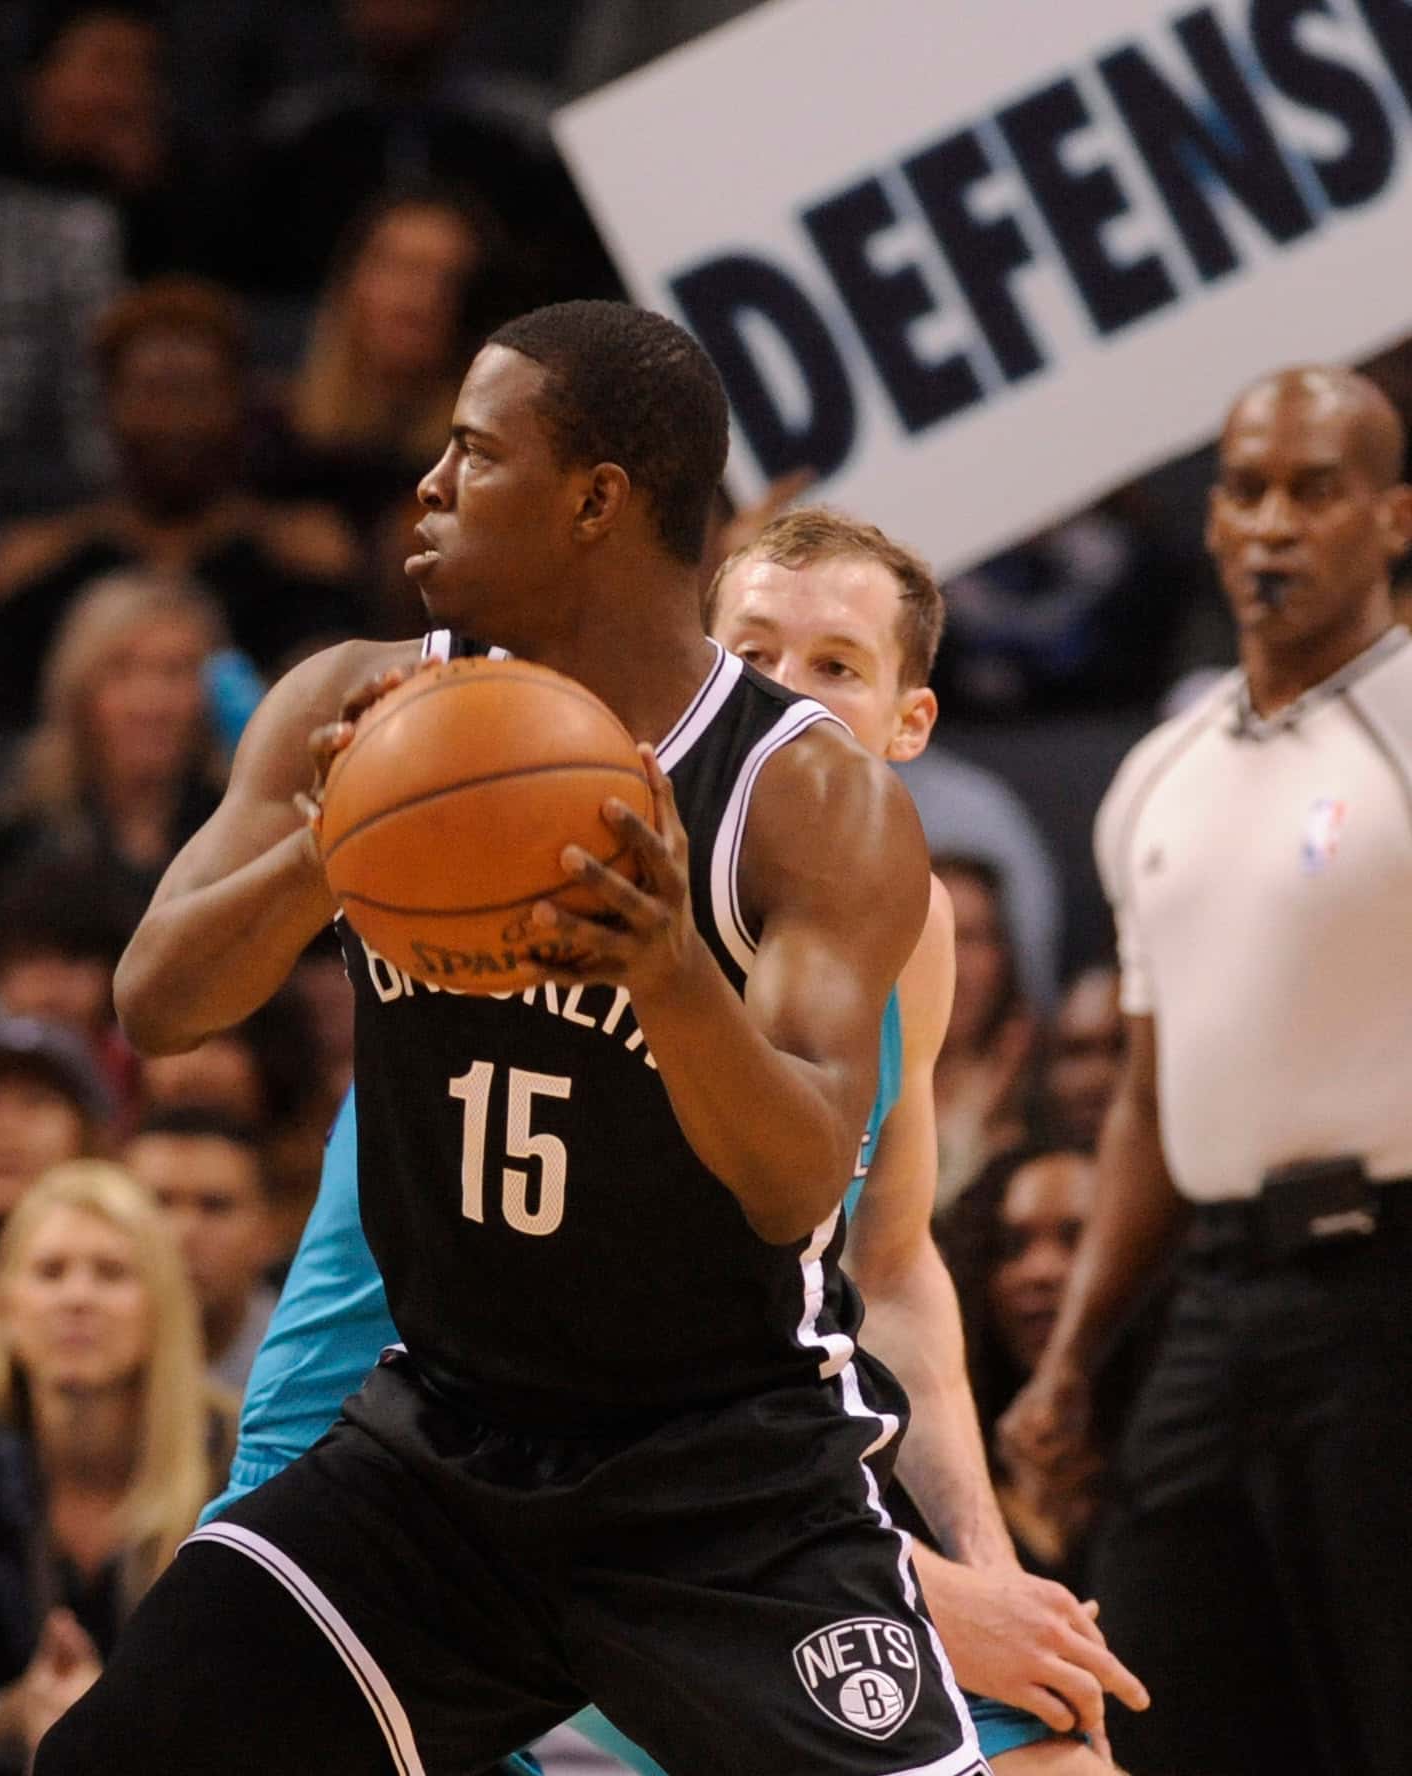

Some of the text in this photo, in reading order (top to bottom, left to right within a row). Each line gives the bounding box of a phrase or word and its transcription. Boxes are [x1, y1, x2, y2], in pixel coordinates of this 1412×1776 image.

[670, 0, 1412, 485] DEFENS
[448, 1060, 572, 1236] 15
[802, 1623, 915, 1689] NETS
[859, 1678, 886, 1721] B
